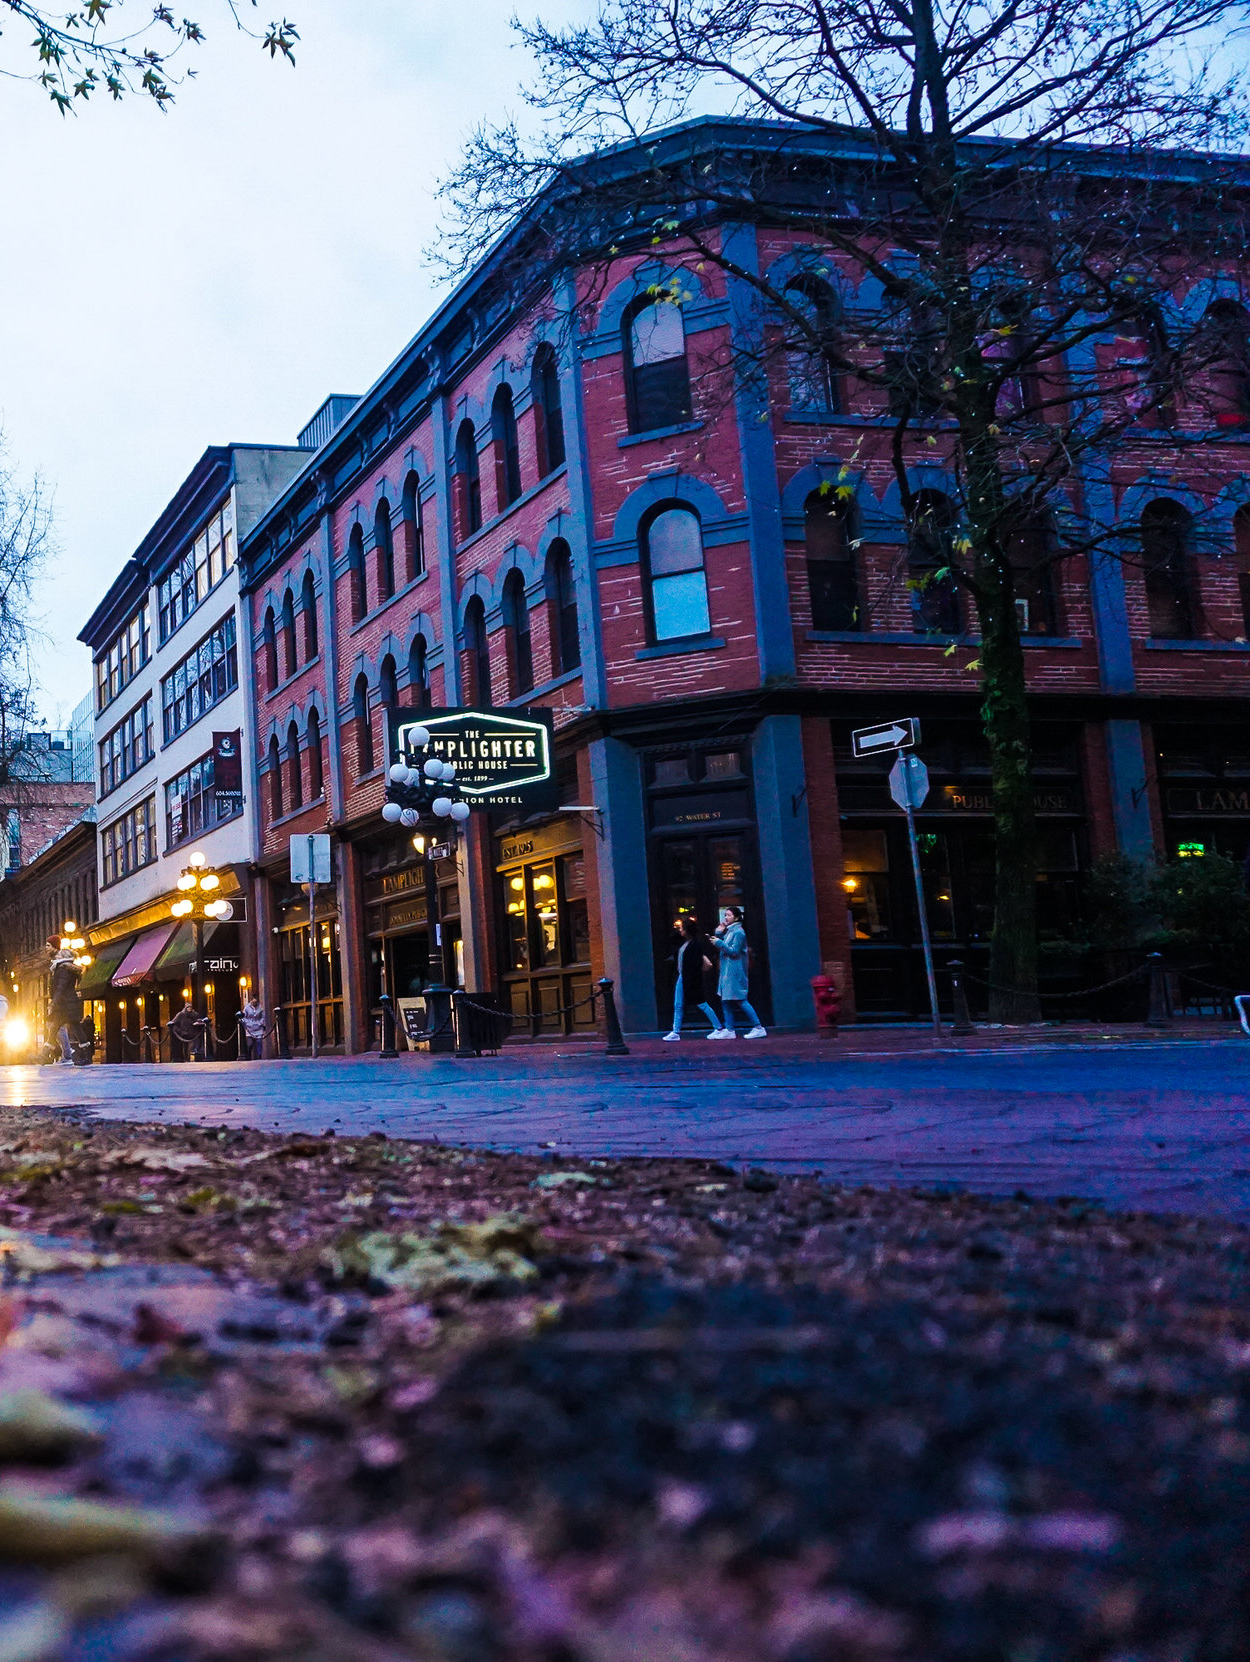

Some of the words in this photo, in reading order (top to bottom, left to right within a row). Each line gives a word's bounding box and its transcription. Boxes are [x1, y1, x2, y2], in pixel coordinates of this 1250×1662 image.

[478, 761, 508, 769] HOUSE
[490, 796, 523, 804] HOTEL
[953, 795, 993, 808] PUBL
